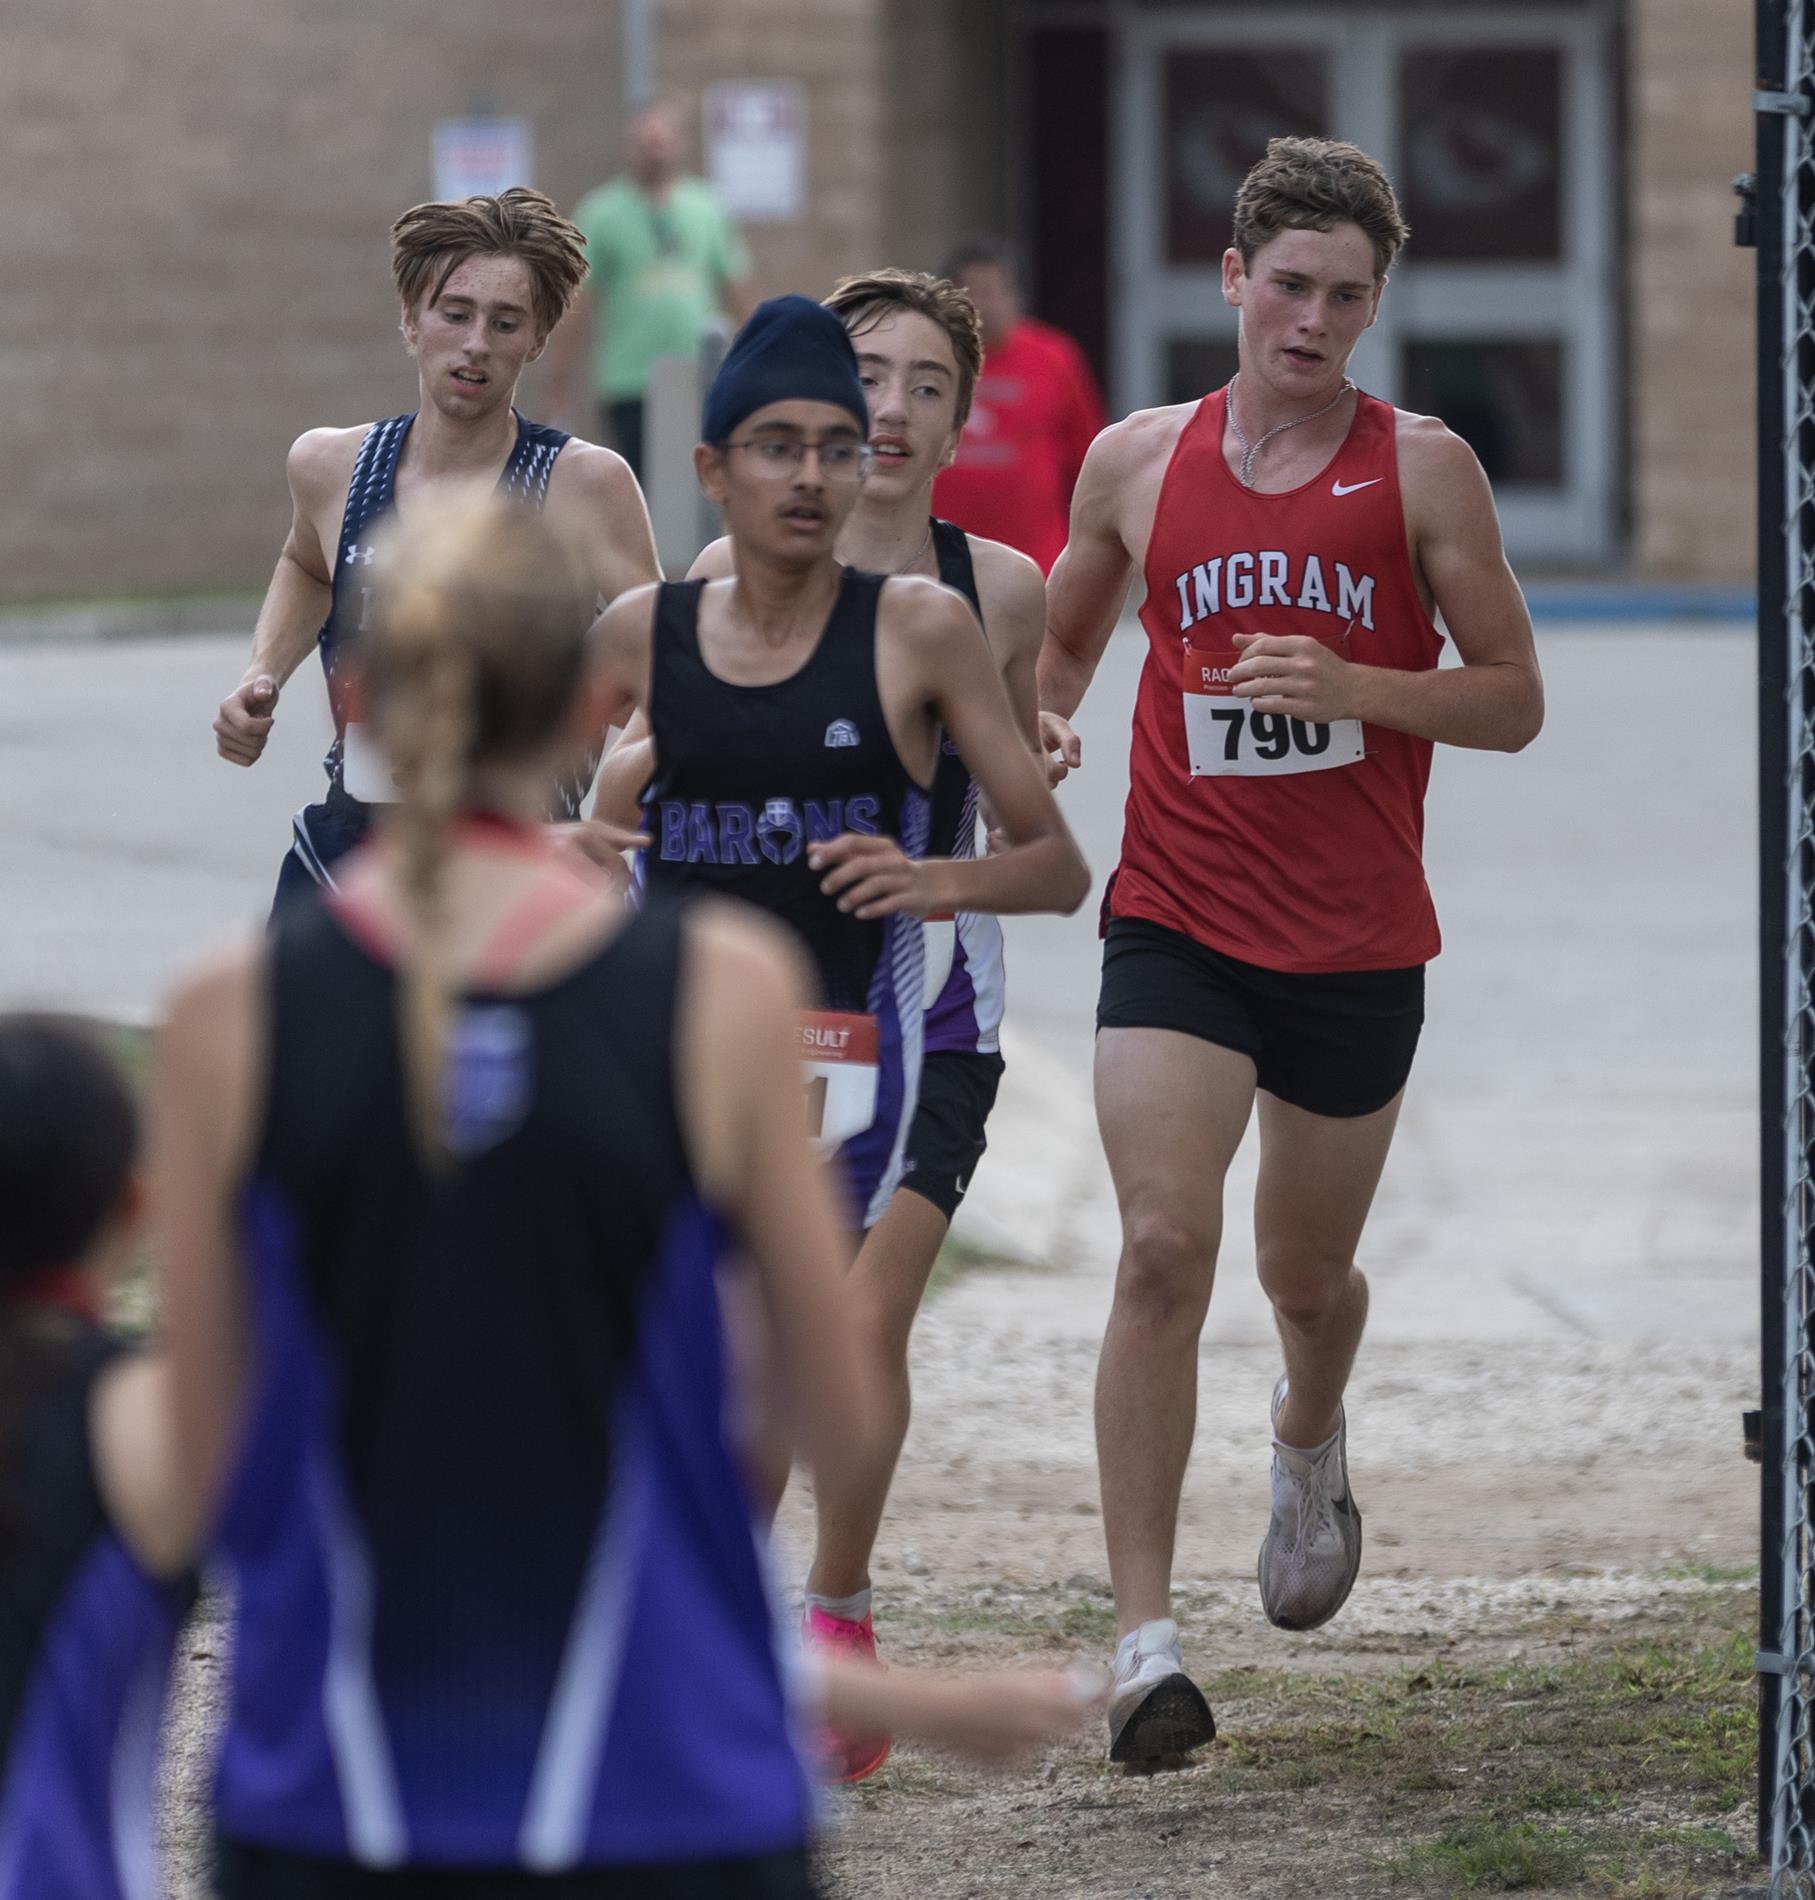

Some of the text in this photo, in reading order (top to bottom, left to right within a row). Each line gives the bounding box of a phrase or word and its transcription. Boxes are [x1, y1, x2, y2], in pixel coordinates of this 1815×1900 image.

[1176, 550, 1375, 632] INGRAM
[1201, 667, 1230, 683] RAC
[1210, 708, 1330, 761] 790
[659, 793, 882, 865] BARONS
